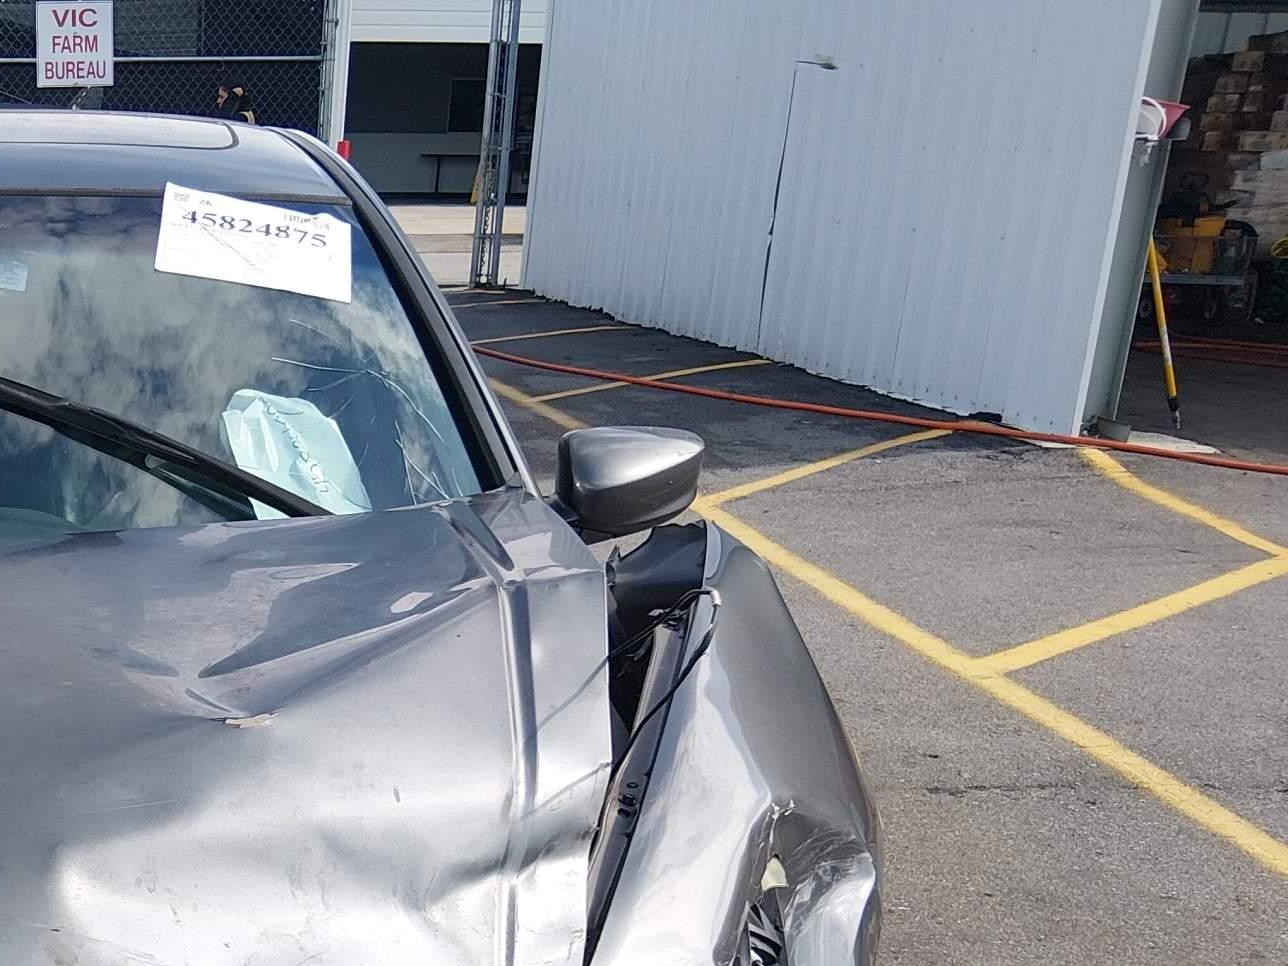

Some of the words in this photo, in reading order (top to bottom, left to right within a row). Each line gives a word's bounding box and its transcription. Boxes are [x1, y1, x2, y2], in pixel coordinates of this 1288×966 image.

[52, 8, 98, 28] VIC
[51, 34, 99, 54] FARM
[44, 60, 106, 80] BUREAU
[182, 210, 327, 248] 45824875
